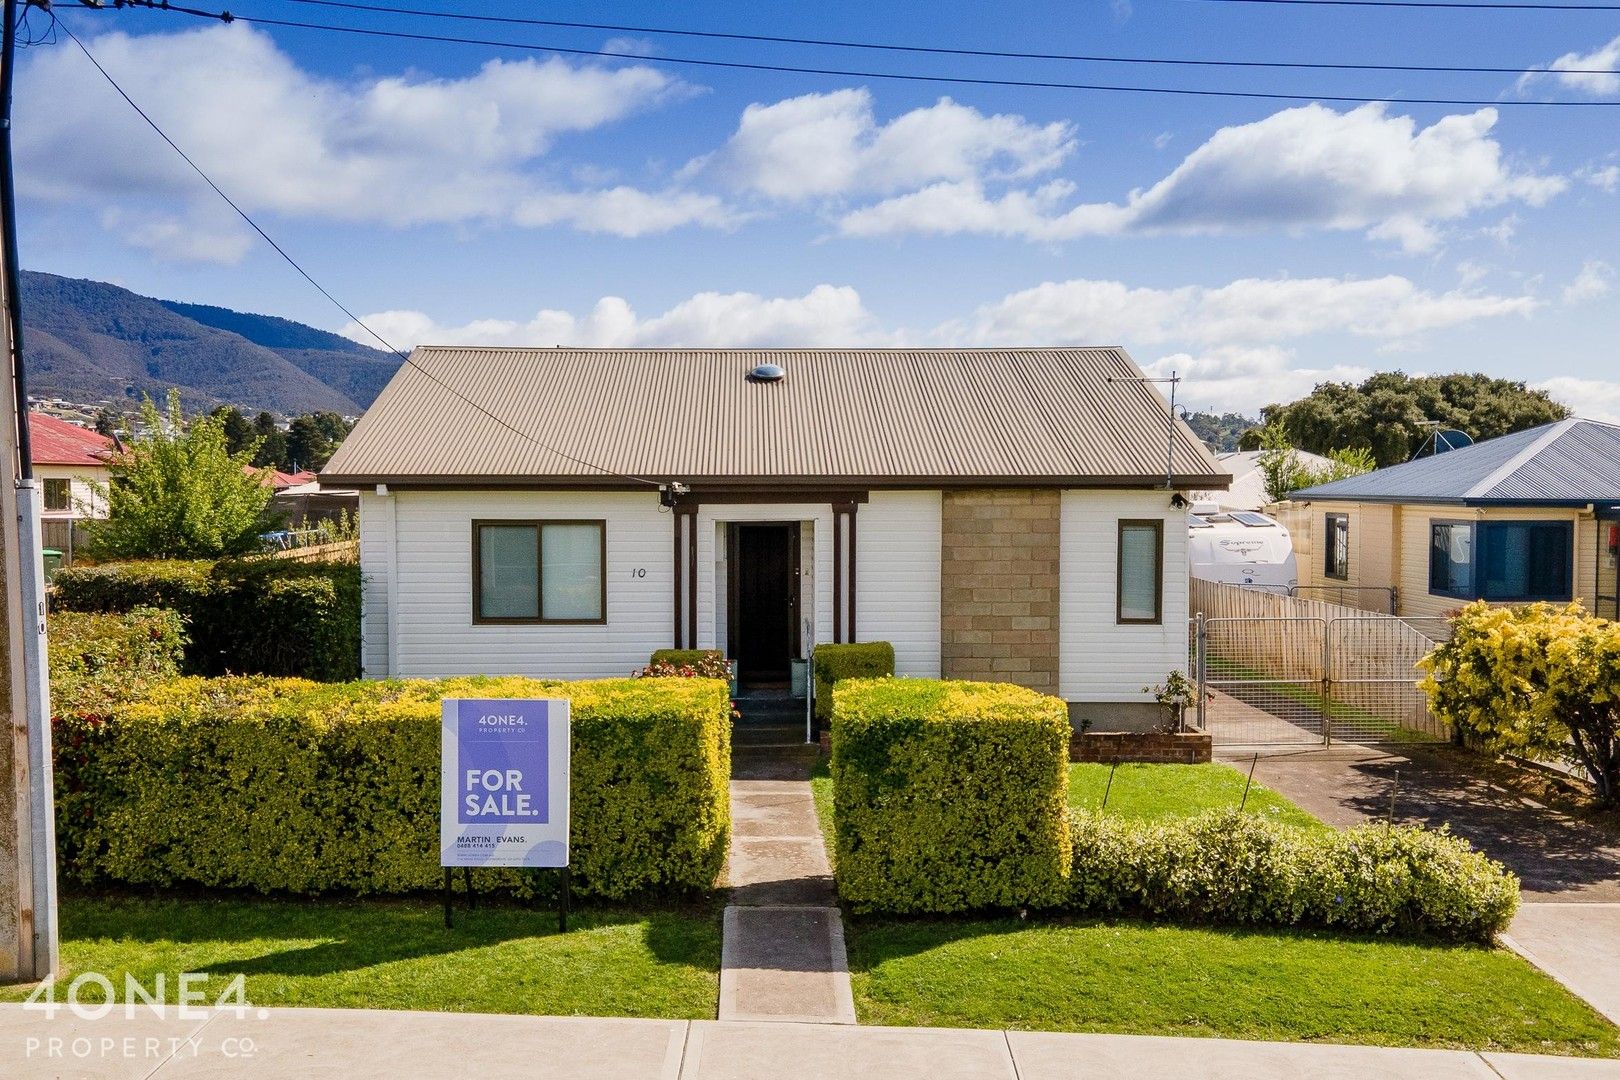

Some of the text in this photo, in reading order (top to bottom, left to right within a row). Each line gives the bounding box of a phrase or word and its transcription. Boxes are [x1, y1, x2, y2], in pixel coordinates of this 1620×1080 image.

[632, 568, 646, 578] 10
[478, 715, 528, 726] 4ONE4.
[466, 769, 523, 792] FOR
[465, 794, 539, 817] SALE.
